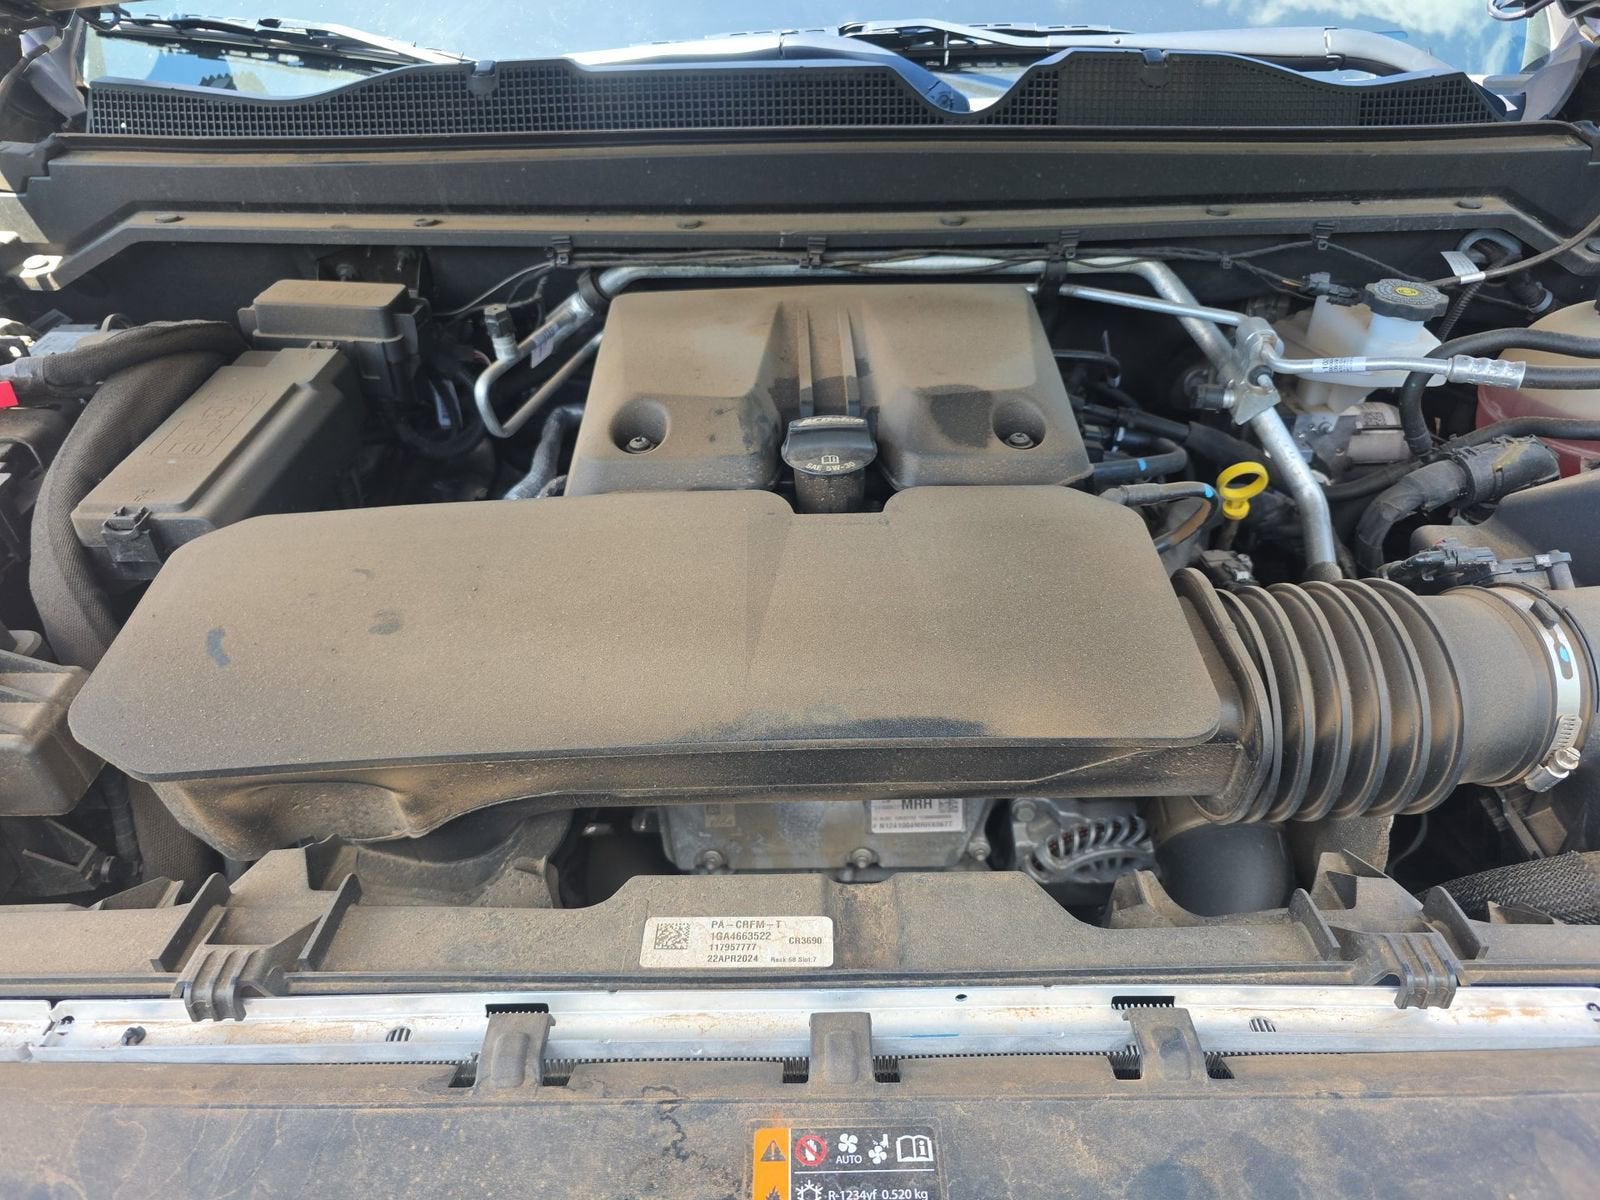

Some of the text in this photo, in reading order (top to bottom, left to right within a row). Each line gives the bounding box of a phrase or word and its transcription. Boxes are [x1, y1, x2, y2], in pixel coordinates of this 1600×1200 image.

[805, 461, 856, 472] SAE 5W-30
[901, 799, 932, 810] MRH
[711, 931, 772, 941] 1GA4663522
[788, 936, 823, 945] CR3690
[709, 943, 757, 951] 117957777
[707, 954, 759, 963] 22APR2024
[835, 1154, 862, 1164] AUTO
[828, 1188, 928, 1200] R-1234yf 0.520 kg
